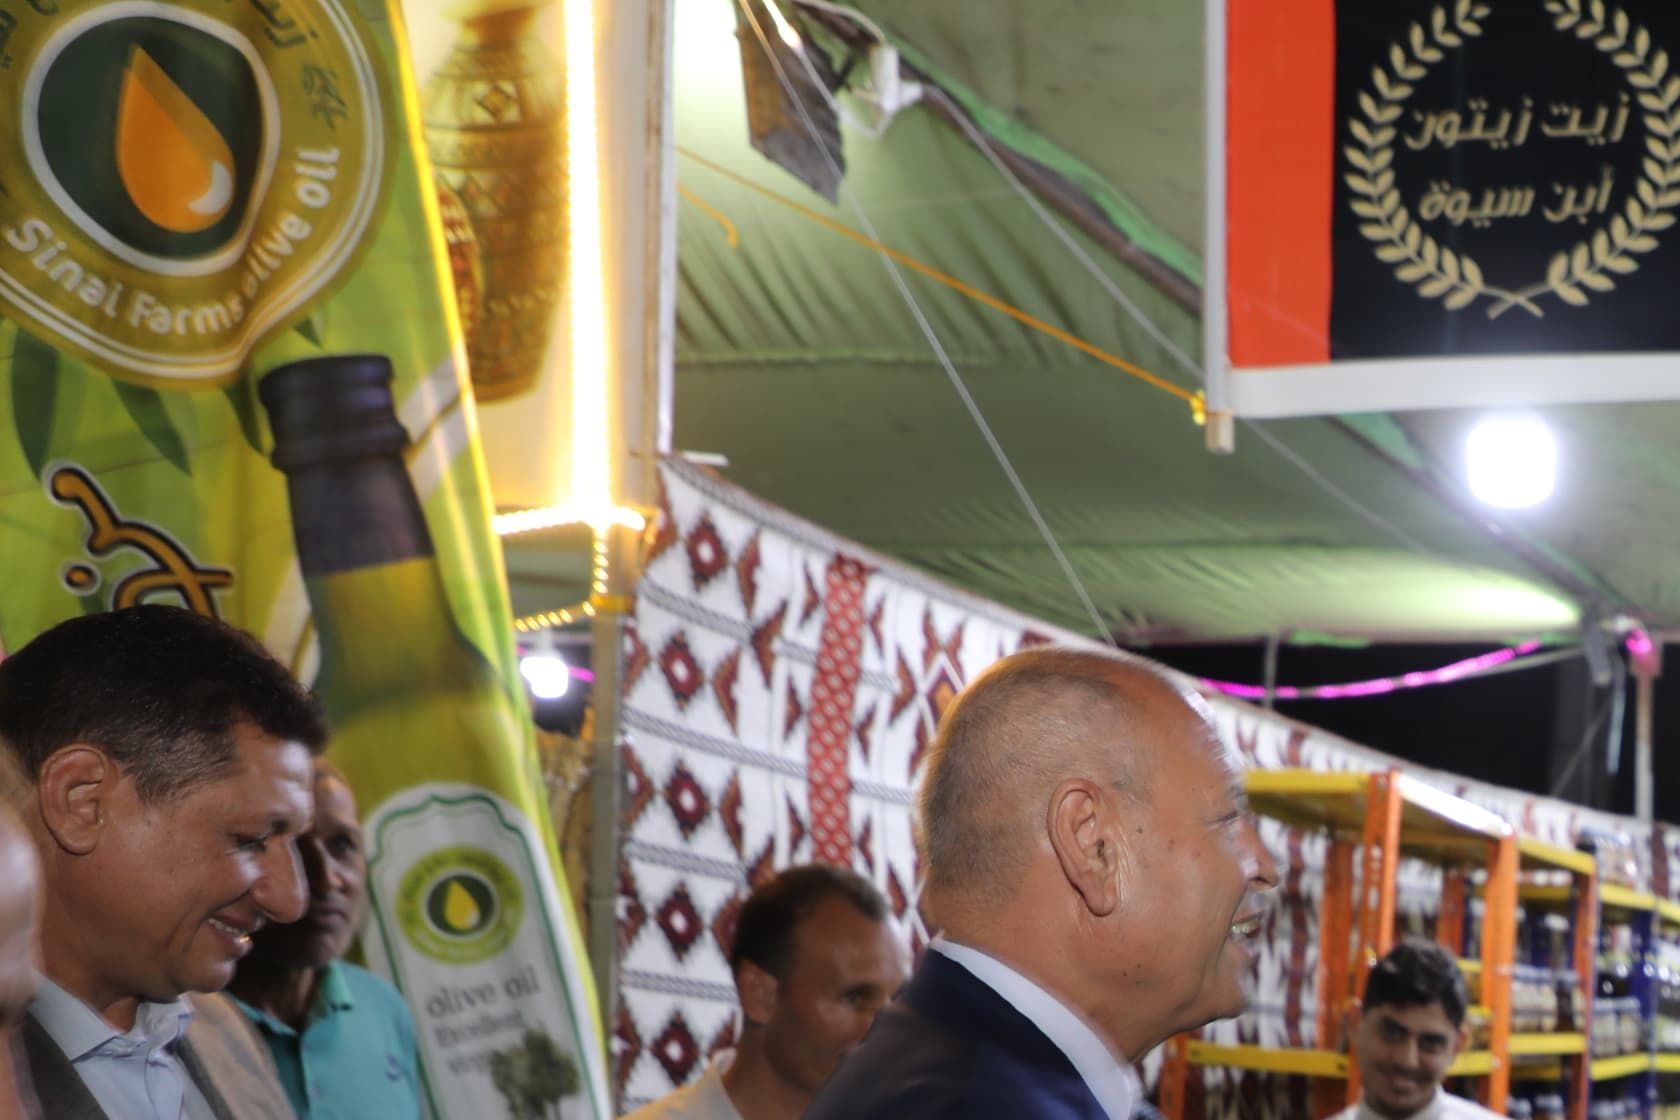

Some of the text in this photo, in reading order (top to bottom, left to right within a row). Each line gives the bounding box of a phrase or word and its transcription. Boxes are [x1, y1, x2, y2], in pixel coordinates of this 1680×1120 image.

[1404, 92, 1632, 150] زيت زيتون
[1418, 180, 1536, 229] سيوة
[6, 146, 342, 336] Sinai Farms olive oil
[426, 965, 541, 1017] olive oil
